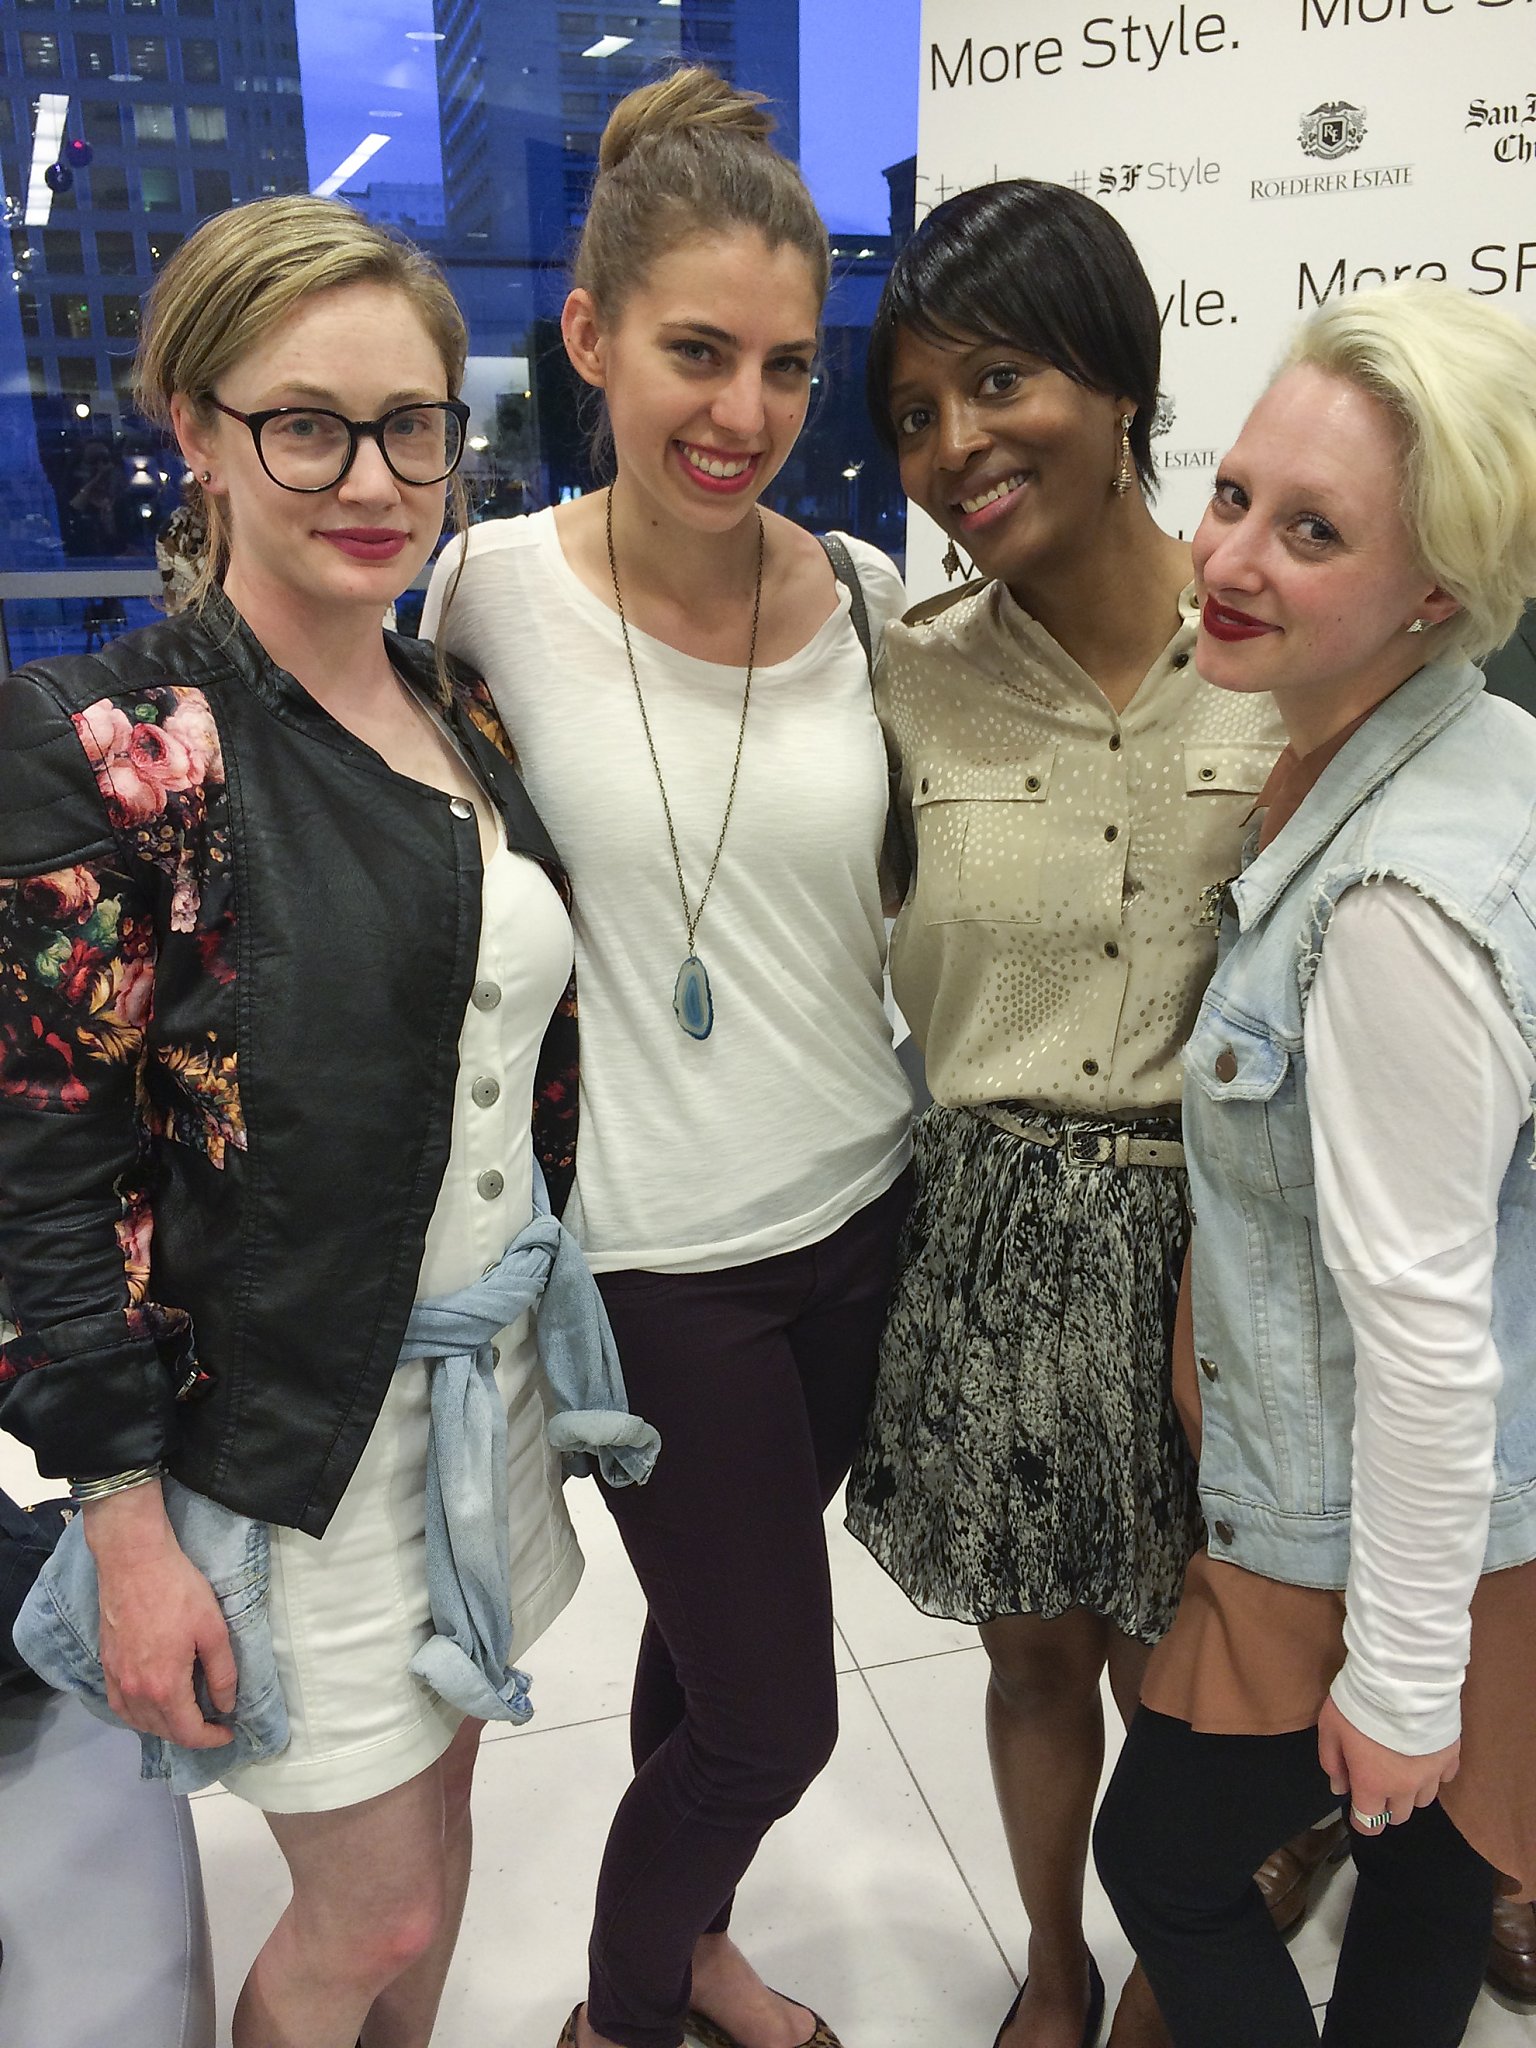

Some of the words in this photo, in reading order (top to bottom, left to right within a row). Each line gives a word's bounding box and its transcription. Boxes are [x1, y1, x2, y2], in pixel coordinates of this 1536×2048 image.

[931, 37, 1063, 91] More
[1081, 4, 1239, 71] Style.
[1464, 99, 1518, 133] San
[1251, 174, 1347, 200] ROEDERER
[1353, 167, 1413, 190] ESTATE
[1164, 451, 1217, 468] ESTATE
